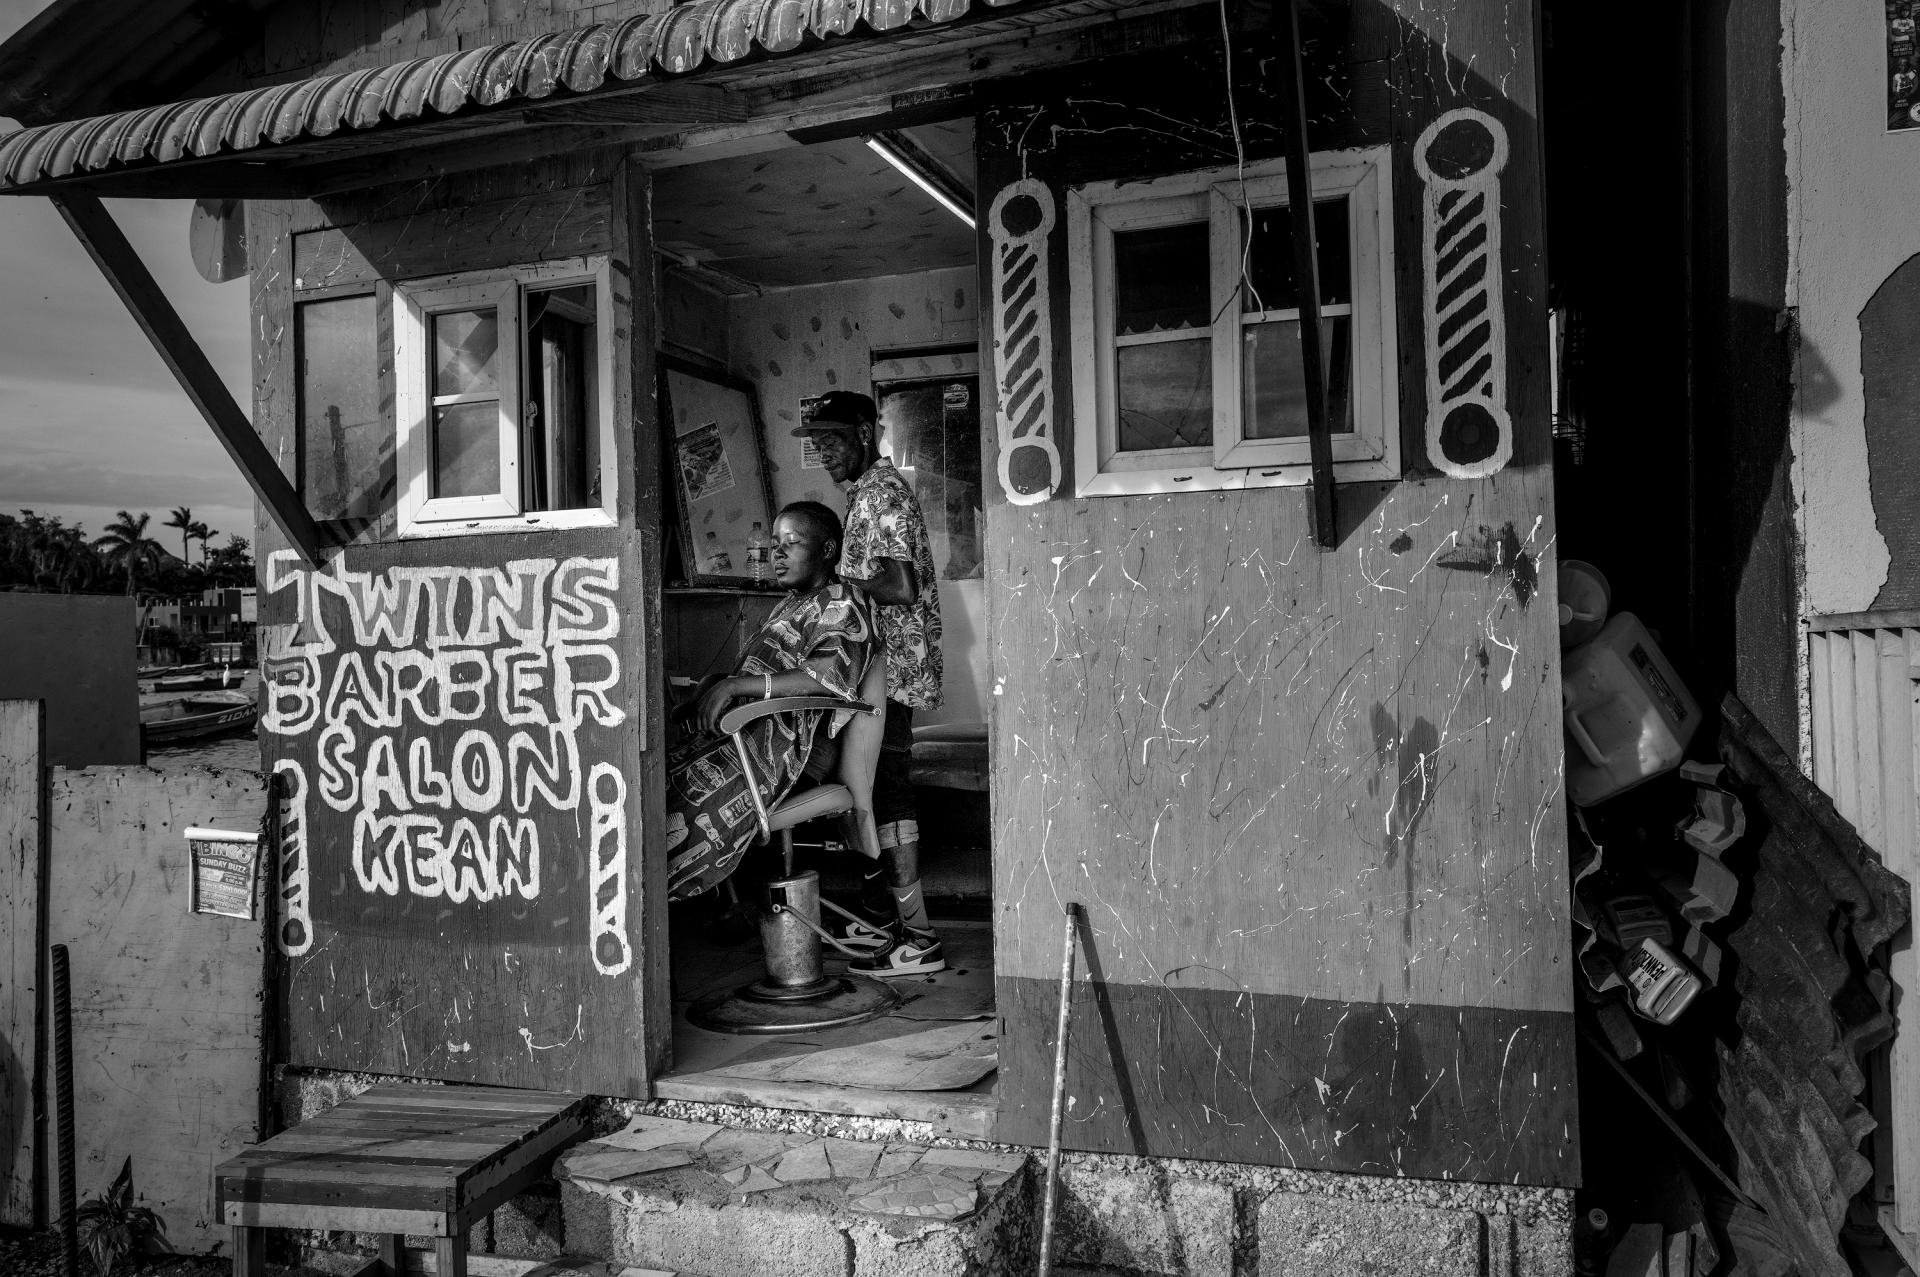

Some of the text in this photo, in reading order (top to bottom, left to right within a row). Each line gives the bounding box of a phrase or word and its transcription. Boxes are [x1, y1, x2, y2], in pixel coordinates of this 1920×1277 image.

[267, 549, 620, 654] TWINS
[261, 643, 626, 735] BARBER
[317, 724, 582, 813] SALON
[200, 857, 246, 873] SUNDAY BUZZ
[201, 841, 250, 863] BINGO
[352, 809, 540, 904] KEAN
